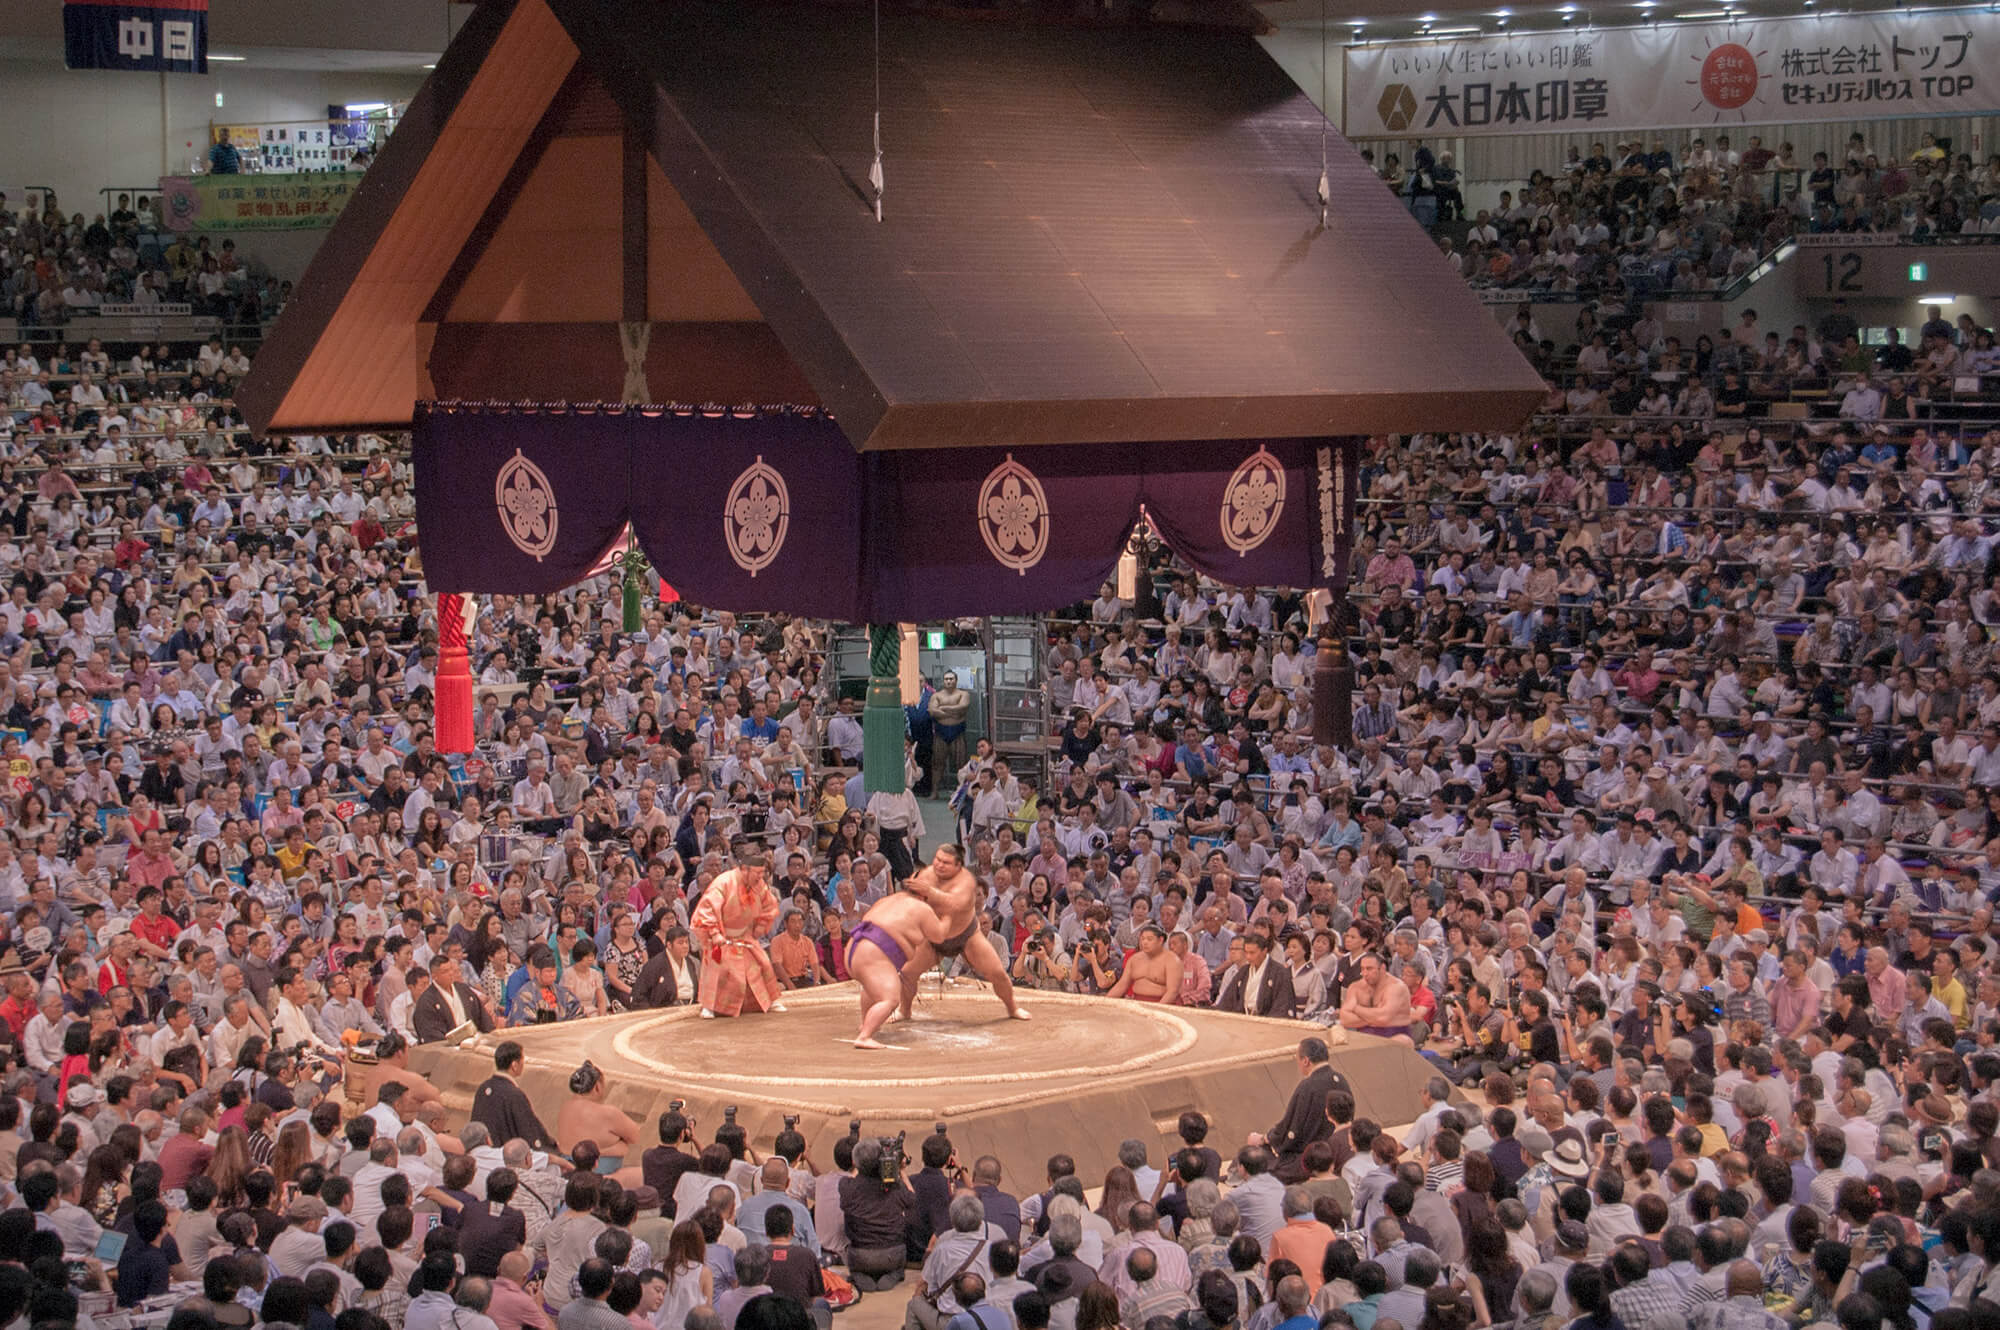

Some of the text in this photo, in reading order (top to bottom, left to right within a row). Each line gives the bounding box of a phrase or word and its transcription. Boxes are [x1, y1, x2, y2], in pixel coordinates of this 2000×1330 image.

[118, 17, 194, 59] 中日
[1391, 43, 1593, 75] いい人生にいい印鑑
[1425, 78, 1608, 129] 大日本印章
[1782, 75, 1974, 105] セキュリティハウス TOP
[1823, 252, 1864, 292] 12
